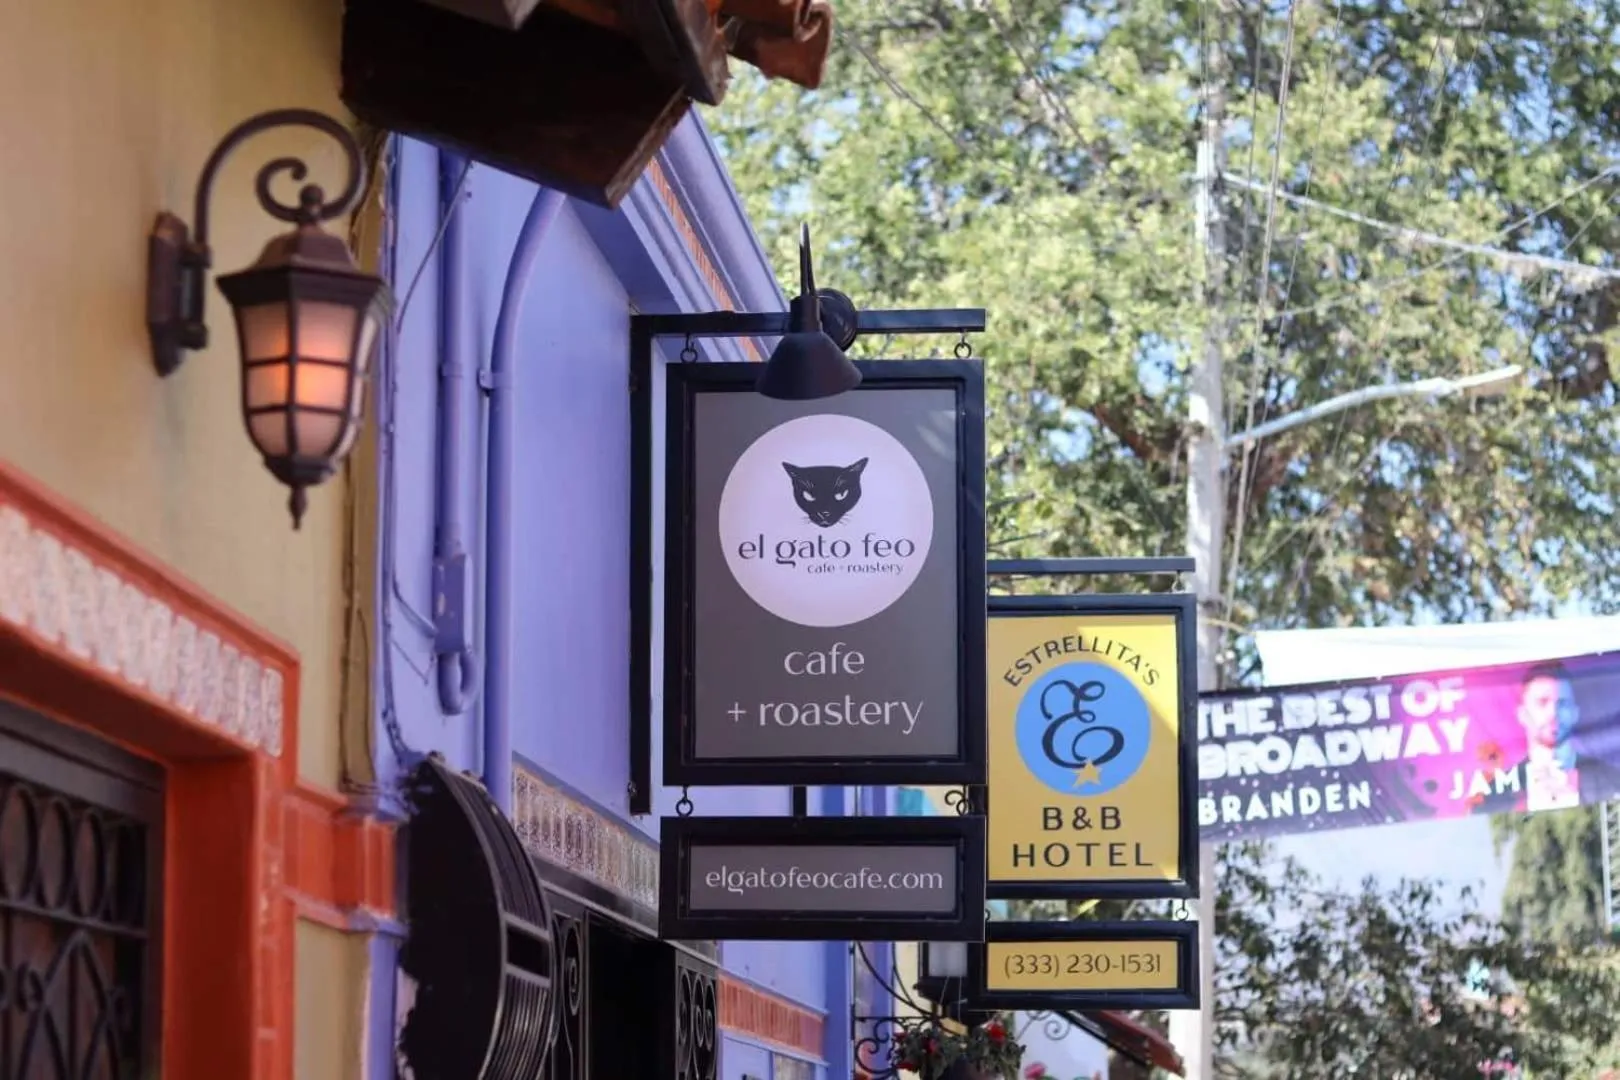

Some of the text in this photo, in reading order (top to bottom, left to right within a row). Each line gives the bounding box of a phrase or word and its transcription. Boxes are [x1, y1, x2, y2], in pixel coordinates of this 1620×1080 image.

[737, 532, 916, 568] el gato feo
[807, 562, 835, 574] cafe
[847, 562, 904, 576] roastery
[784, 642, 865, 676] cafe
[1003, 634, 1160, 688] ESTRELLITA'S
[759, 695, 924, 735] roastery
[1281, 684, 1392, 730] BEST
[1401, 676, 1466, 718] OF
[1198, 716, 1470, 781] BROADWAY
[1198, 780, 1371, 826] BRANDEN
[1012, 842, 1154, 868] HOTEL
[705, 865, 944, 895] elgatofeocafe.com
[1004, 953, 1161, 979] (333) 230-1531
